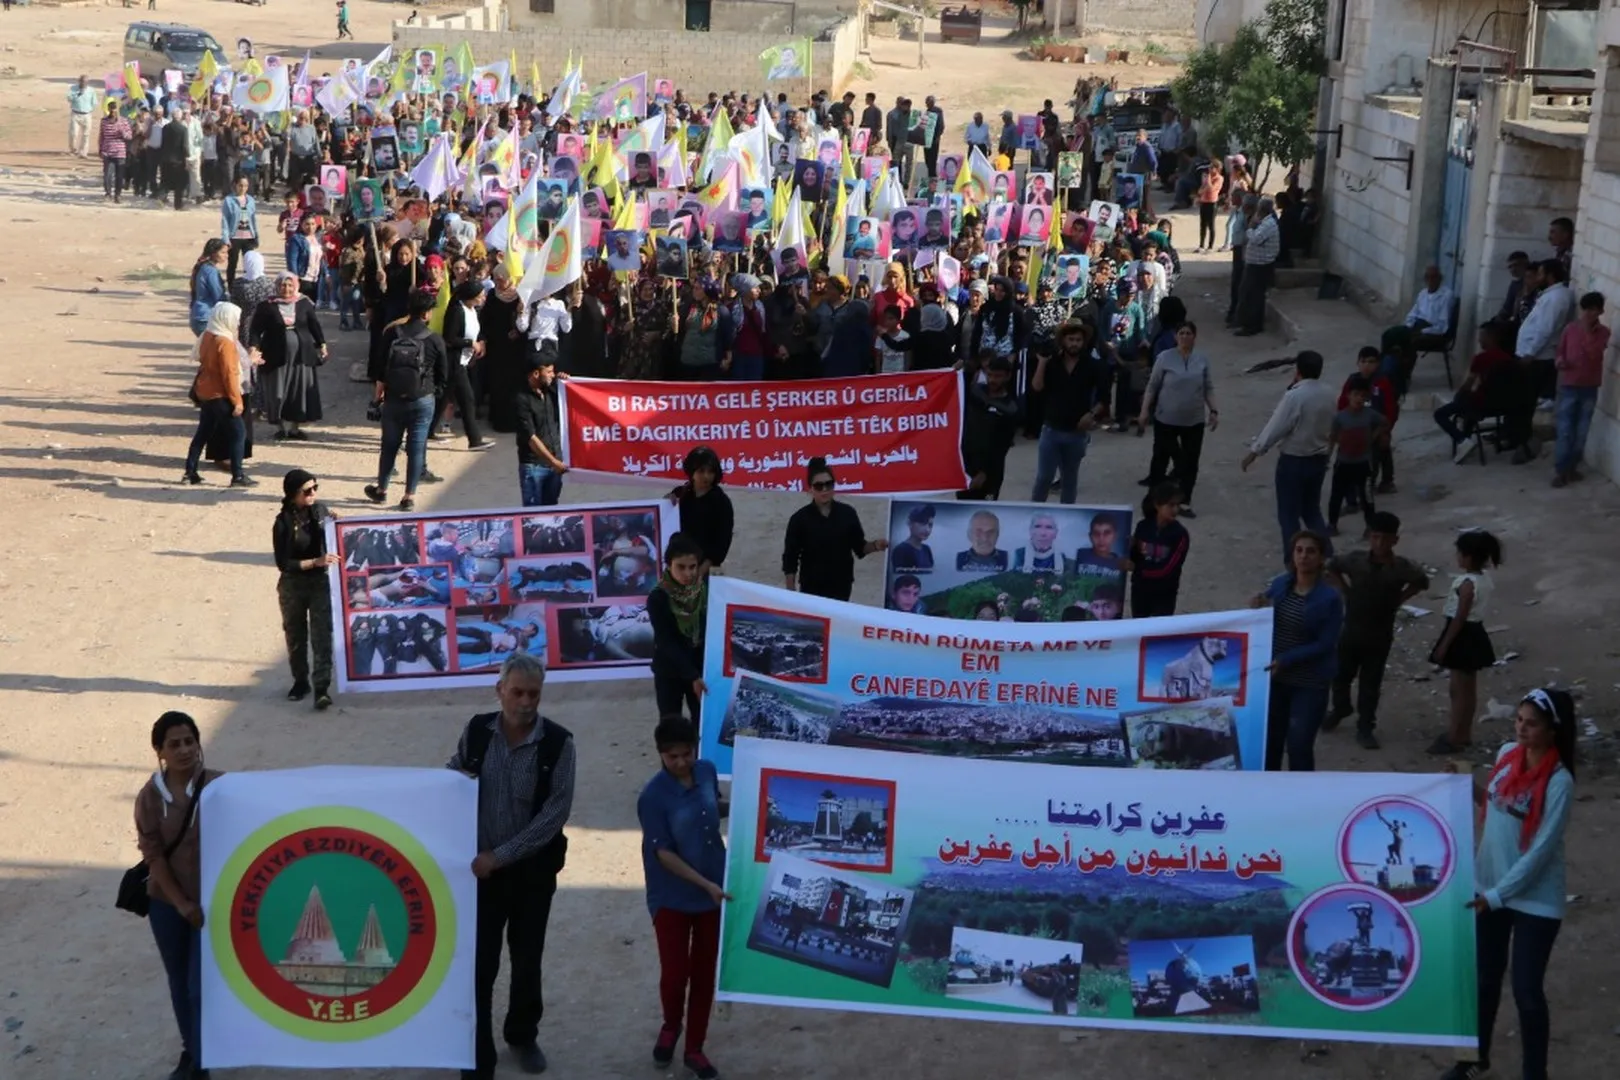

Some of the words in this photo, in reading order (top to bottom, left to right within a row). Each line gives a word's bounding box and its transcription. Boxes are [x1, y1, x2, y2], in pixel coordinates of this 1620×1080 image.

[608, 395, 626, 412] BI
[630, 394, 710, 412] RASTIYA
[715, 388, 761, 409] GELÊ
[766, 388, 837, 411] ŞERKER
[842, 386, 856, 405] Û
[860, 384, 928, 404] GERÎLA
[582, 423, 622, 442] EMÊ
[626, 420, 752, 442] DAGIRKERIYÊ
[756, 419, 769, 439] Û
[773, 416, 855, 438] ÎXANETÊ
[858, 415, 894, 435] TÊK
[898, 411, 949, 432] BIBIN
[864, 444, 919, 466] بالحرب
[862, 624, 930, 646] EFRÎN
[936, 633, 1034, 652] RÛMETA
[961, 652, 1000, 673] EM
[850, 674, 991, 701] CANFEDAYÊ
[996, 676, 1080, 707] EFRÎNÊ
[1086, 687, 1118, 708] NE
[1047, 798, 1143, 835] كرامتنا
[1151, 804, 1226, 836] عفرين
[938, 832, 1014, 865] عفرين
[1021, 830, 1071, 871] أجل
[1078, 845, 1117, 873] من
[1125, 841, 1229, 876] فدائيون
[1235, 848, 1284, 878] نحن
